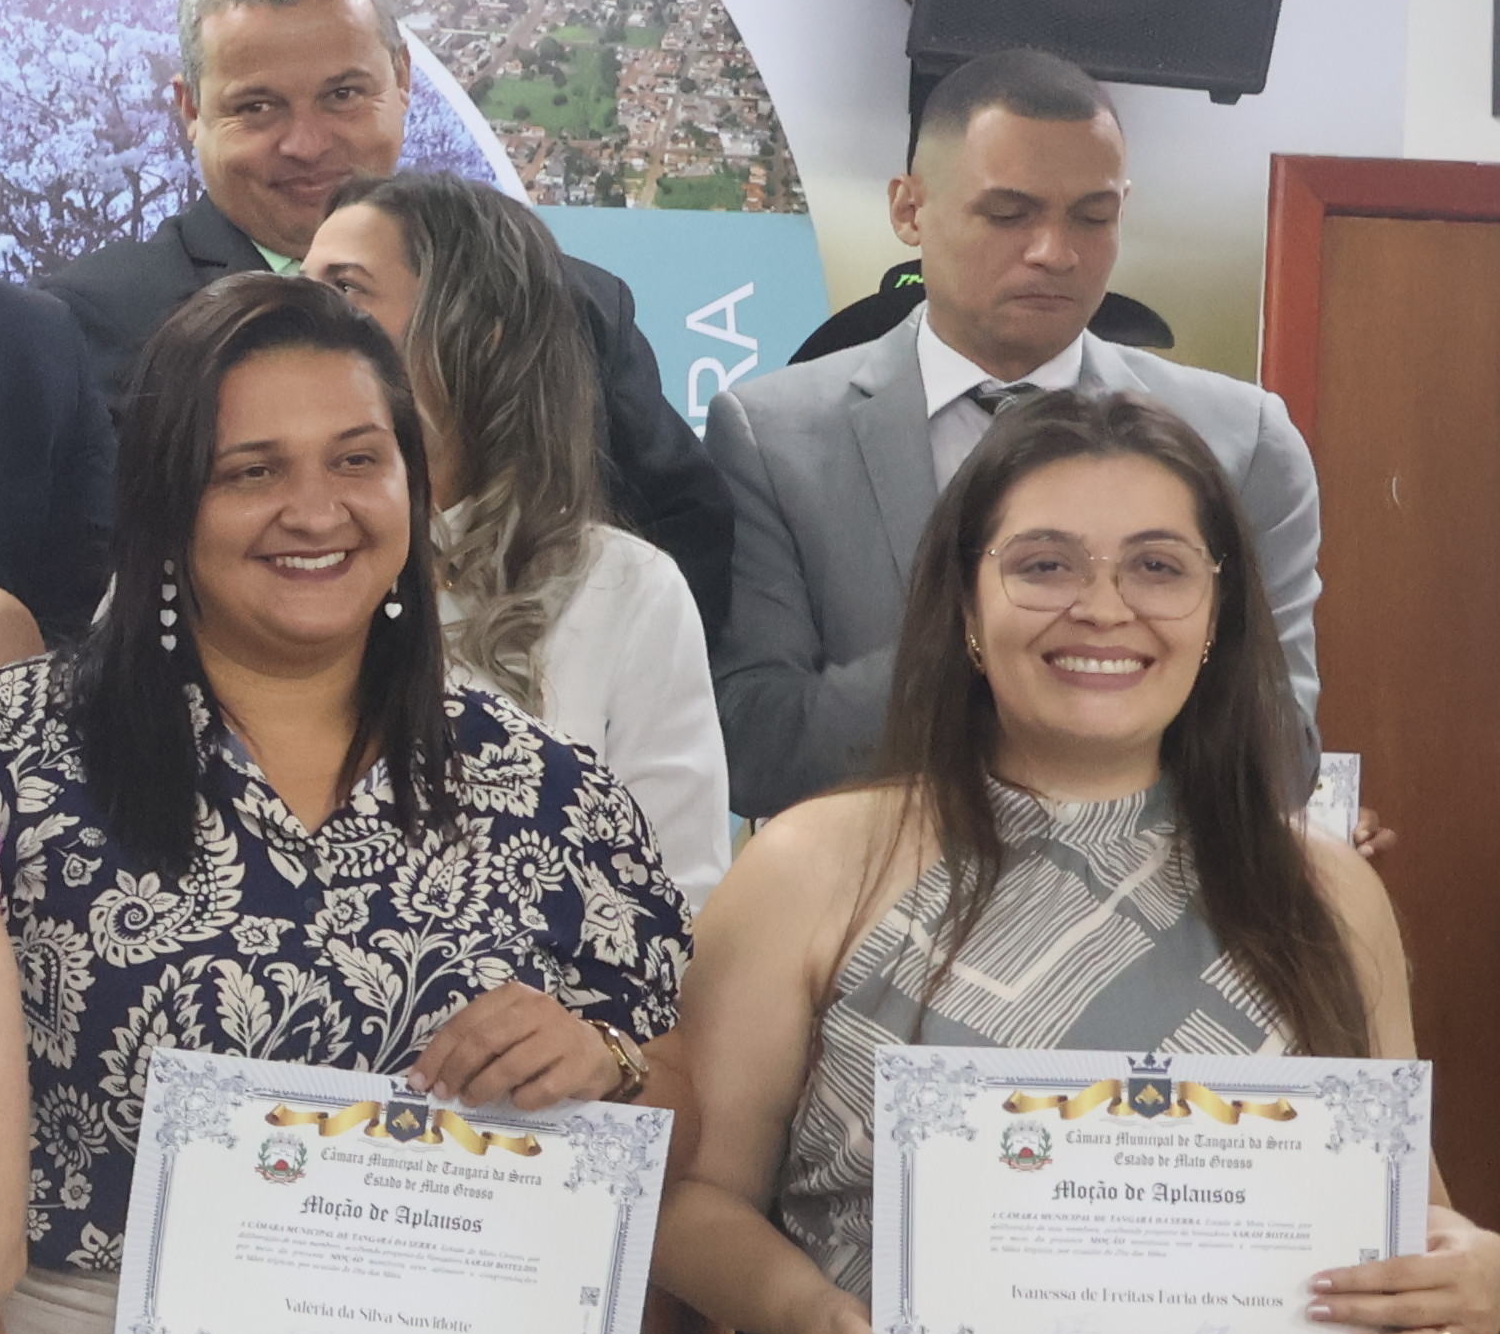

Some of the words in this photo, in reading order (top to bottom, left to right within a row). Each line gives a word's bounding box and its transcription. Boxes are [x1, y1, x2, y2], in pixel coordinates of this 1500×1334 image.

[1113, 1151, 1155, 1167] Estado
[1157, 1153, 1171, 1167] de
[1173, 1153, 1206, 1169] Mato
[1208, 1154, 1253, 1170] Grosso
[1051, 1179, 1118, 1205] Moção
[1124, 1182, 1146, 1202] de
[1152, 1182, 1246, 1206] Aplausos
[299, 1194, 363, 1222] Moção
[369, 1202, 390, 1223] de
[394, 1205, 484, 1234] Aplausos
[1080, 1287, 1098, 1302] de
[1201, 1291, 1229, 1306] dos
[1231, 1293, 1284, 1308] Santos
[337, 1304, 355, 1320] da
[359, 1307, 393, 1324] Silva
